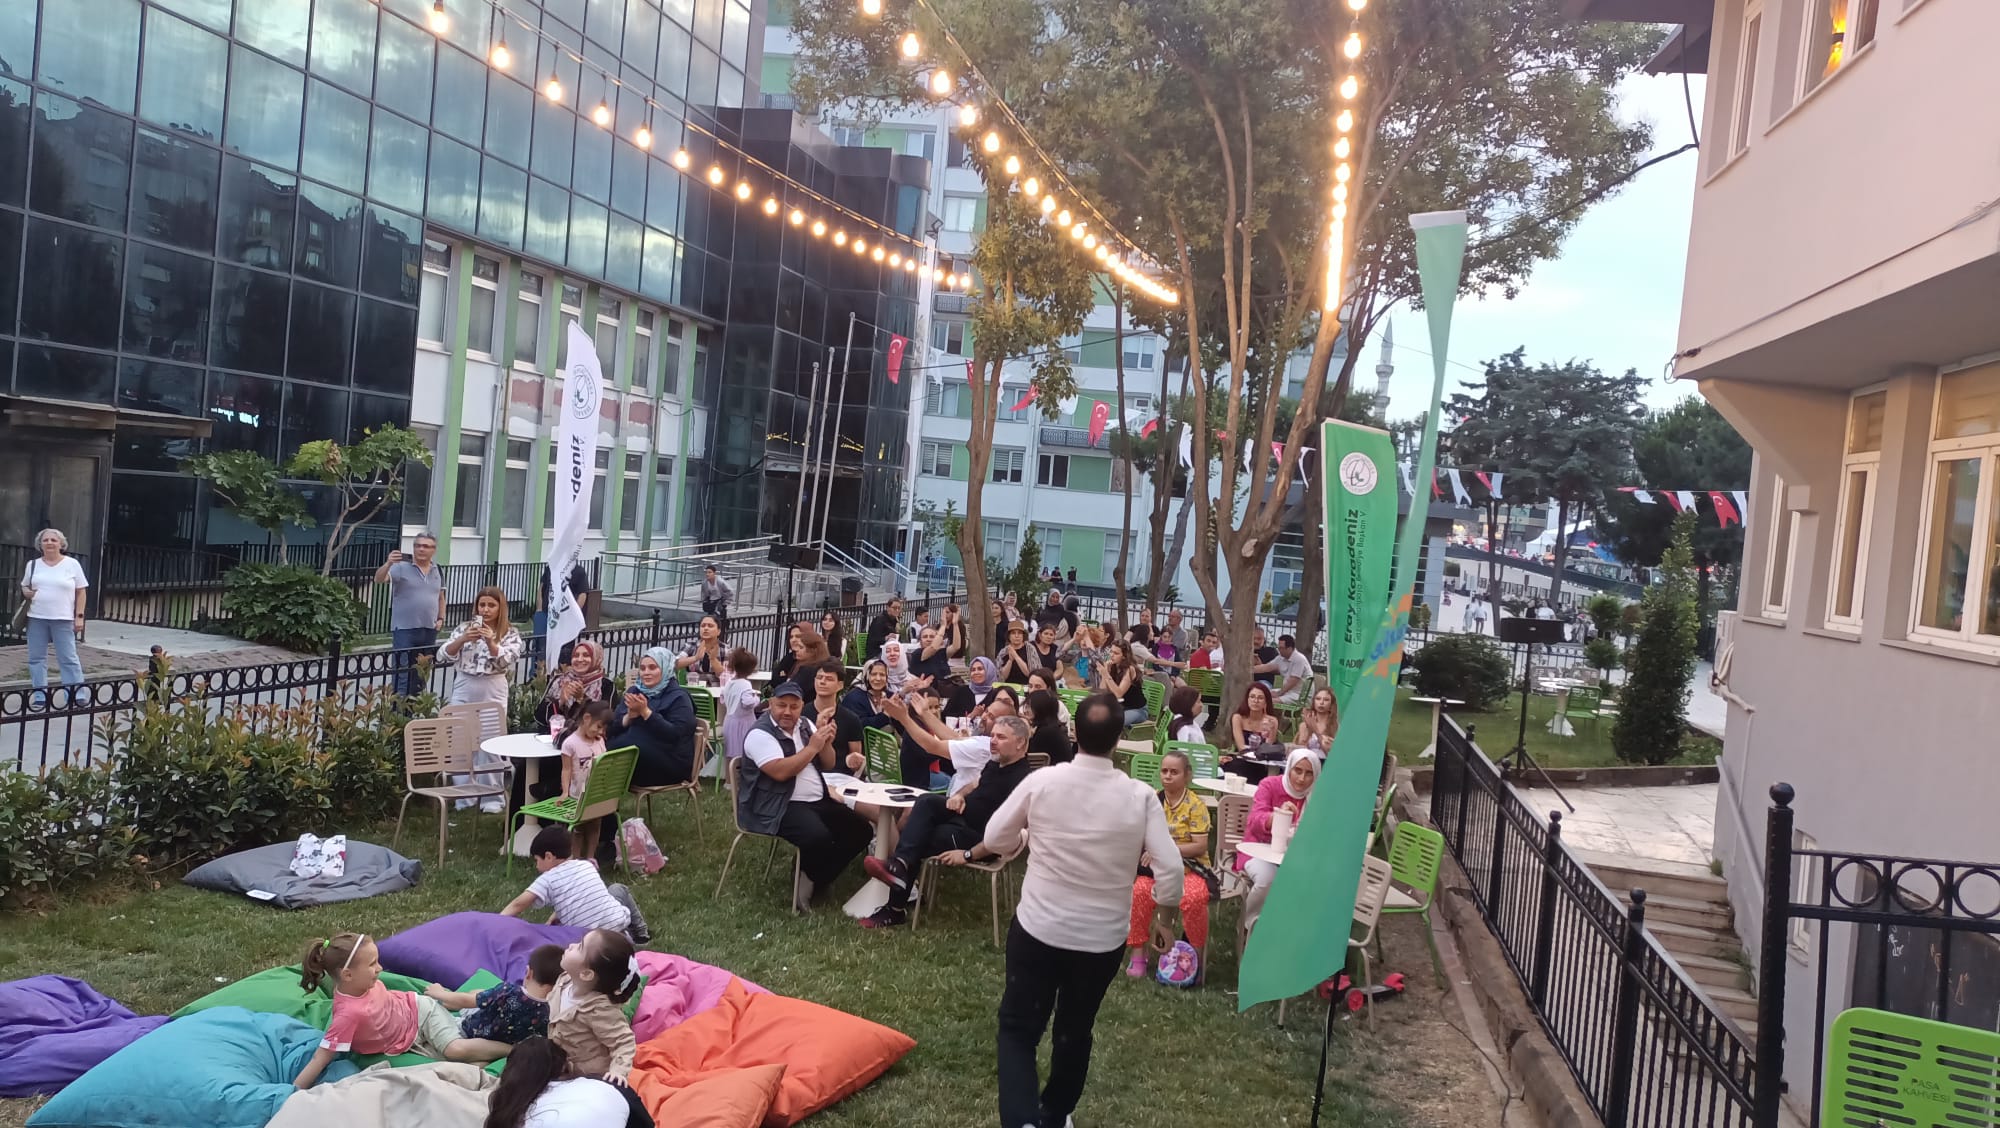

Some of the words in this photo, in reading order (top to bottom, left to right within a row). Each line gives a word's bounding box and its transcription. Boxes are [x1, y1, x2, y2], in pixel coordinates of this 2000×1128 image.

[570, 434, 582, 504] deniz
[1344, 509, 1359, 601] Karadeniz
[1344, 604, 1356, 644] Eray
